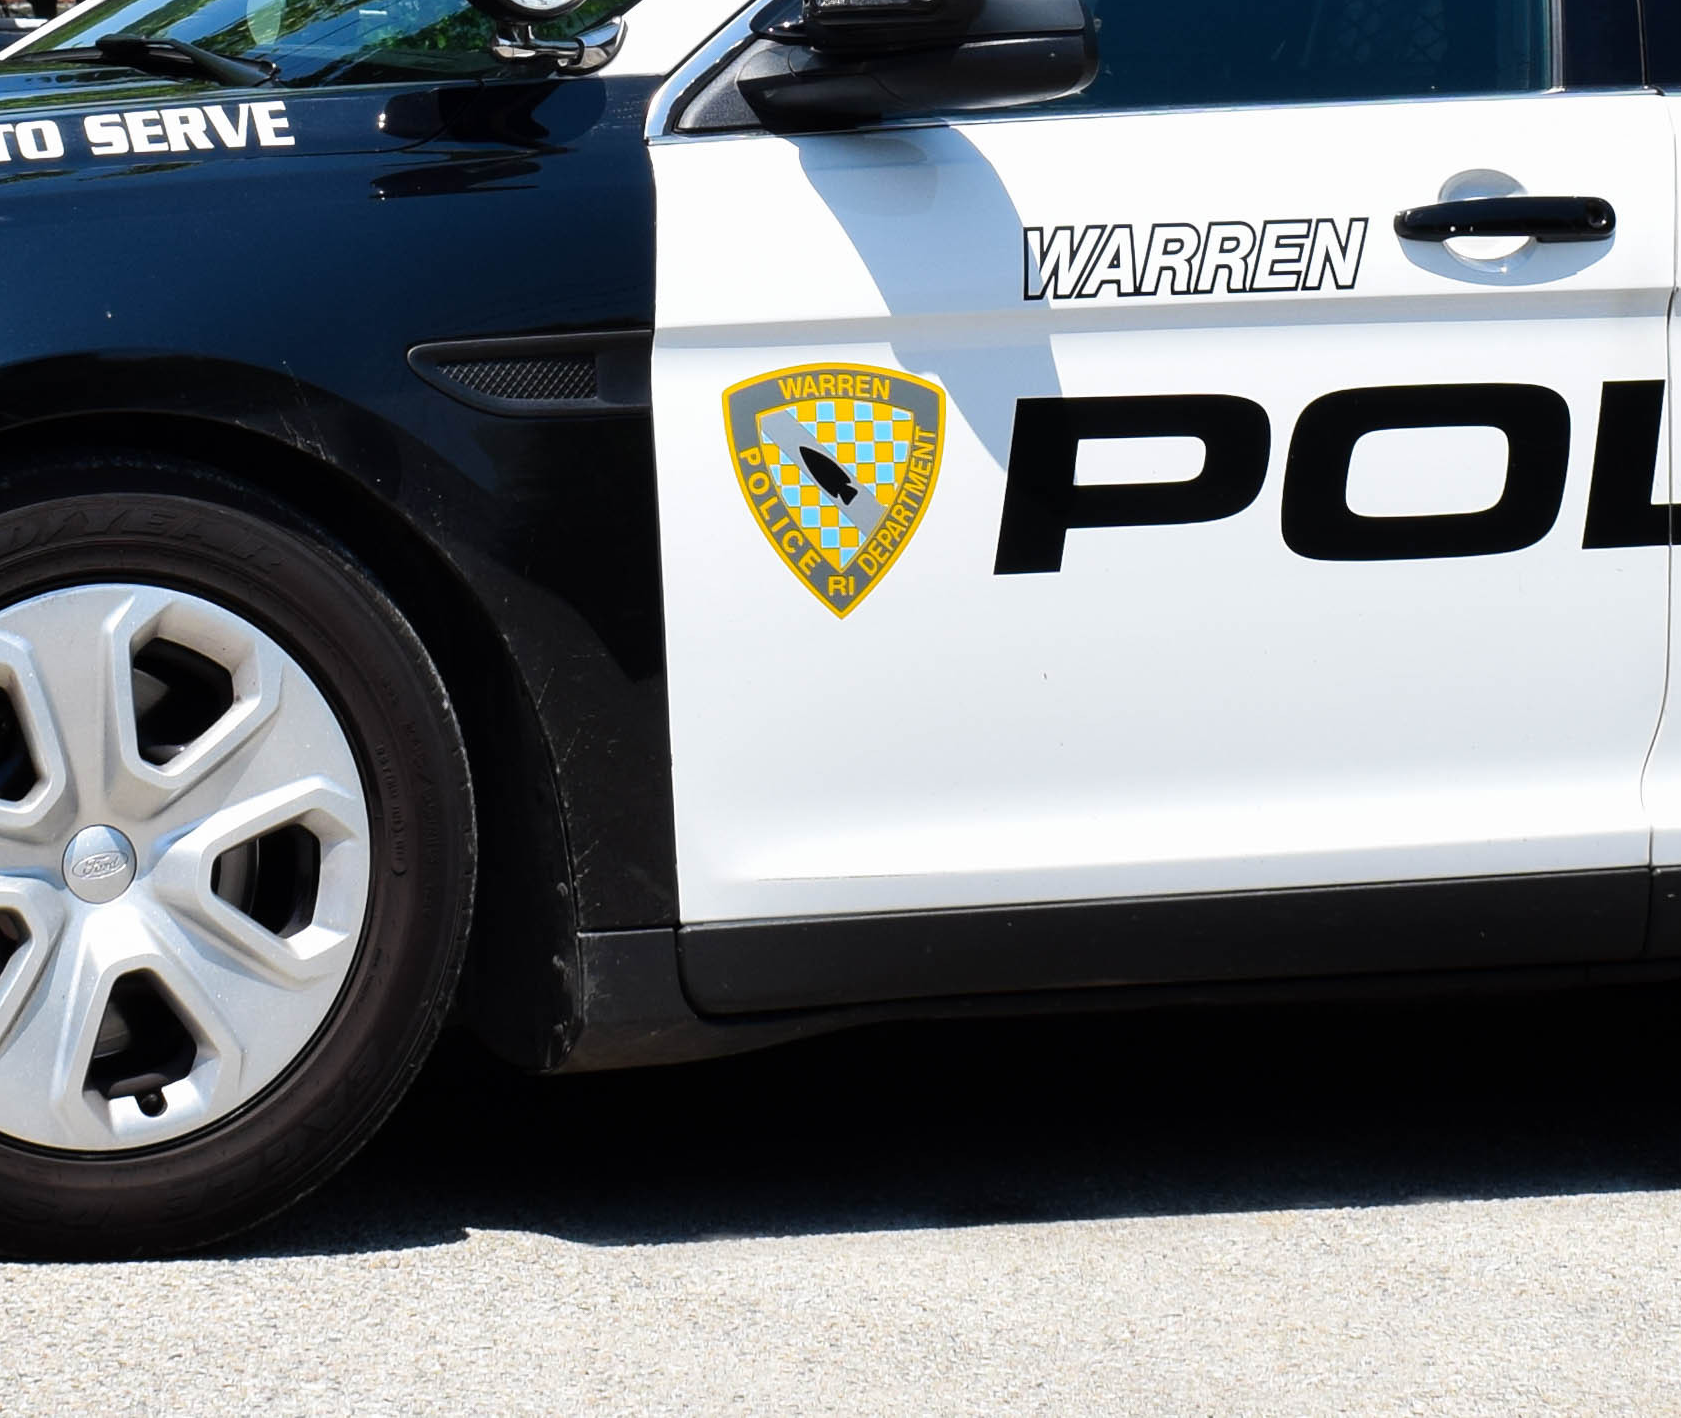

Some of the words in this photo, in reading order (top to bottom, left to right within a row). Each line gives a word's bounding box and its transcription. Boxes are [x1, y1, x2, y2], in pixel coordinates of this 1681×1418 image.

[90, 100, 296, 158] SERVE
[1023, 217, 1369, 302] WARREN
[778, 374, 891, 400] WARREN
[740, 446, 822, 576] POLICE
[857, 425, 936, 577] DEPARTMENT
[827, 575, 856, 596] RI
